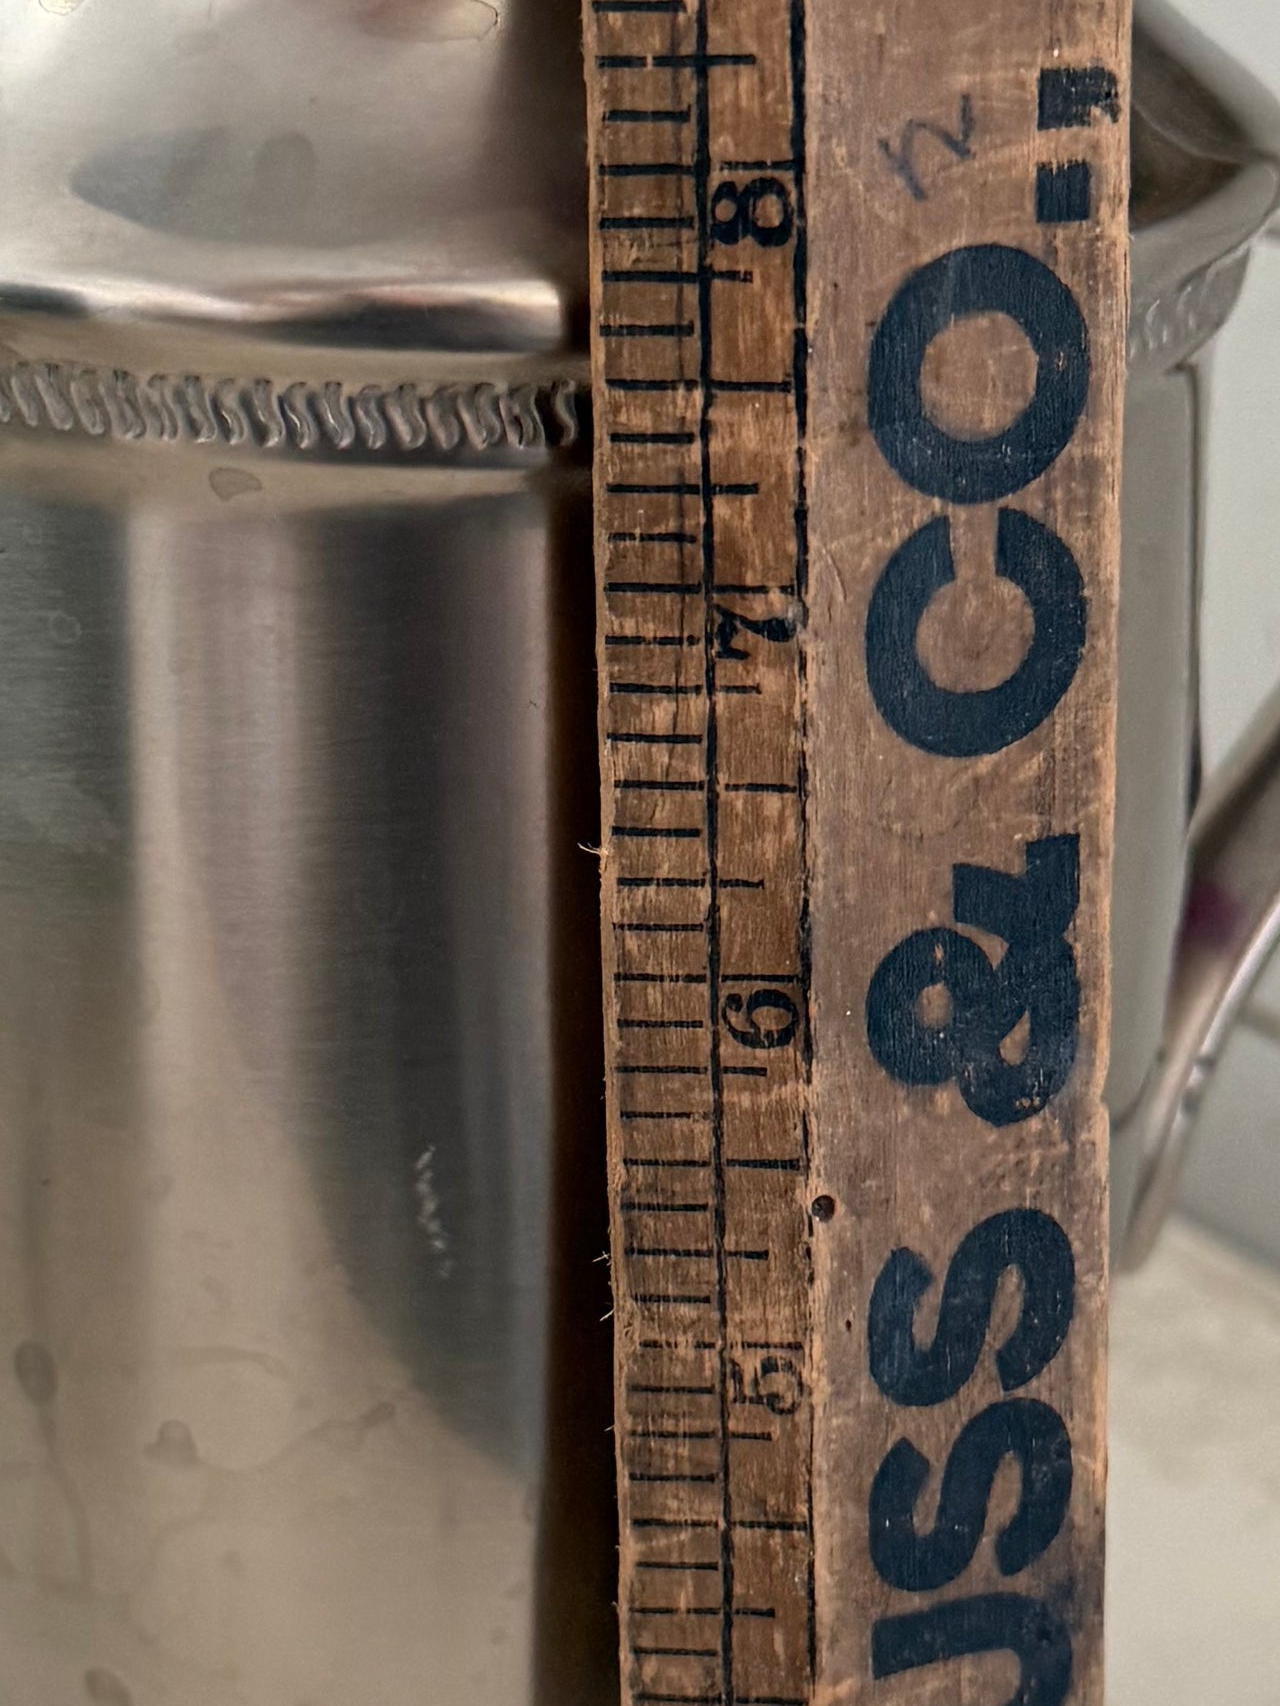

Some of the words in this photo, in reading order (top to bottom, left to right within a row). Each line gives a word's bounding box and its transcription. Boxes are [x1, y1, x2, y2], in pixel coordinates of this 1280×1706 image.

[710, 175, 796, 249] 8
[709, 600, 799, 662] 7
[864, 832, 1081, 1129] &
[721, 986, 802, 1051] 6
[729, 1355, 806, 1416] 5
